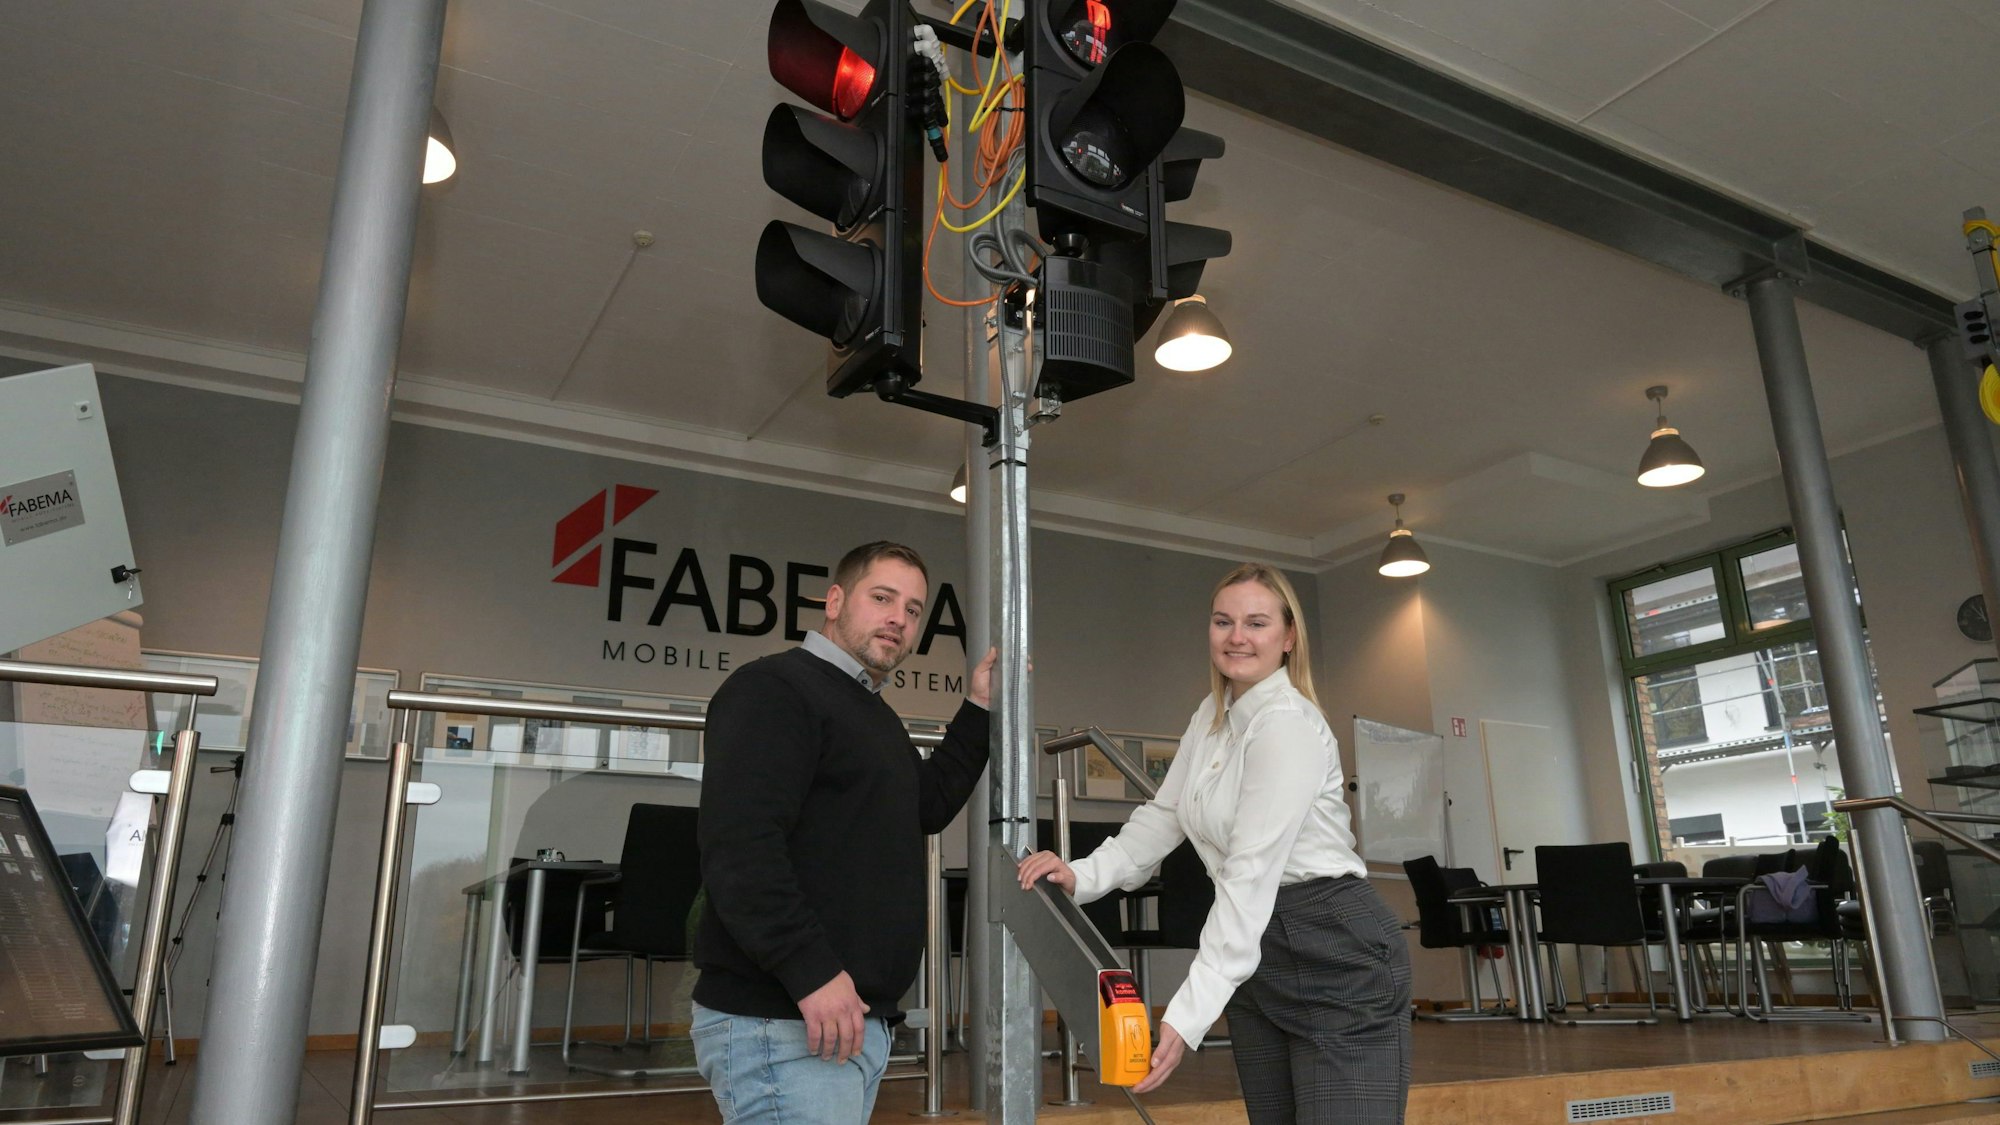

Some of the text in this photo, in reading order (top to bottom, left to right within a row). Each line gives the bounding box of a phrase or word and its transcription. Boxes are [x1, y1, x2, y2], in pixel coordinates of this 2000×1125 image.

[8, 489, 73, 518] FABEMA
[607, 537, 966, 656] FABEA
[603, 640, 962, 693] MOBILE STEM
